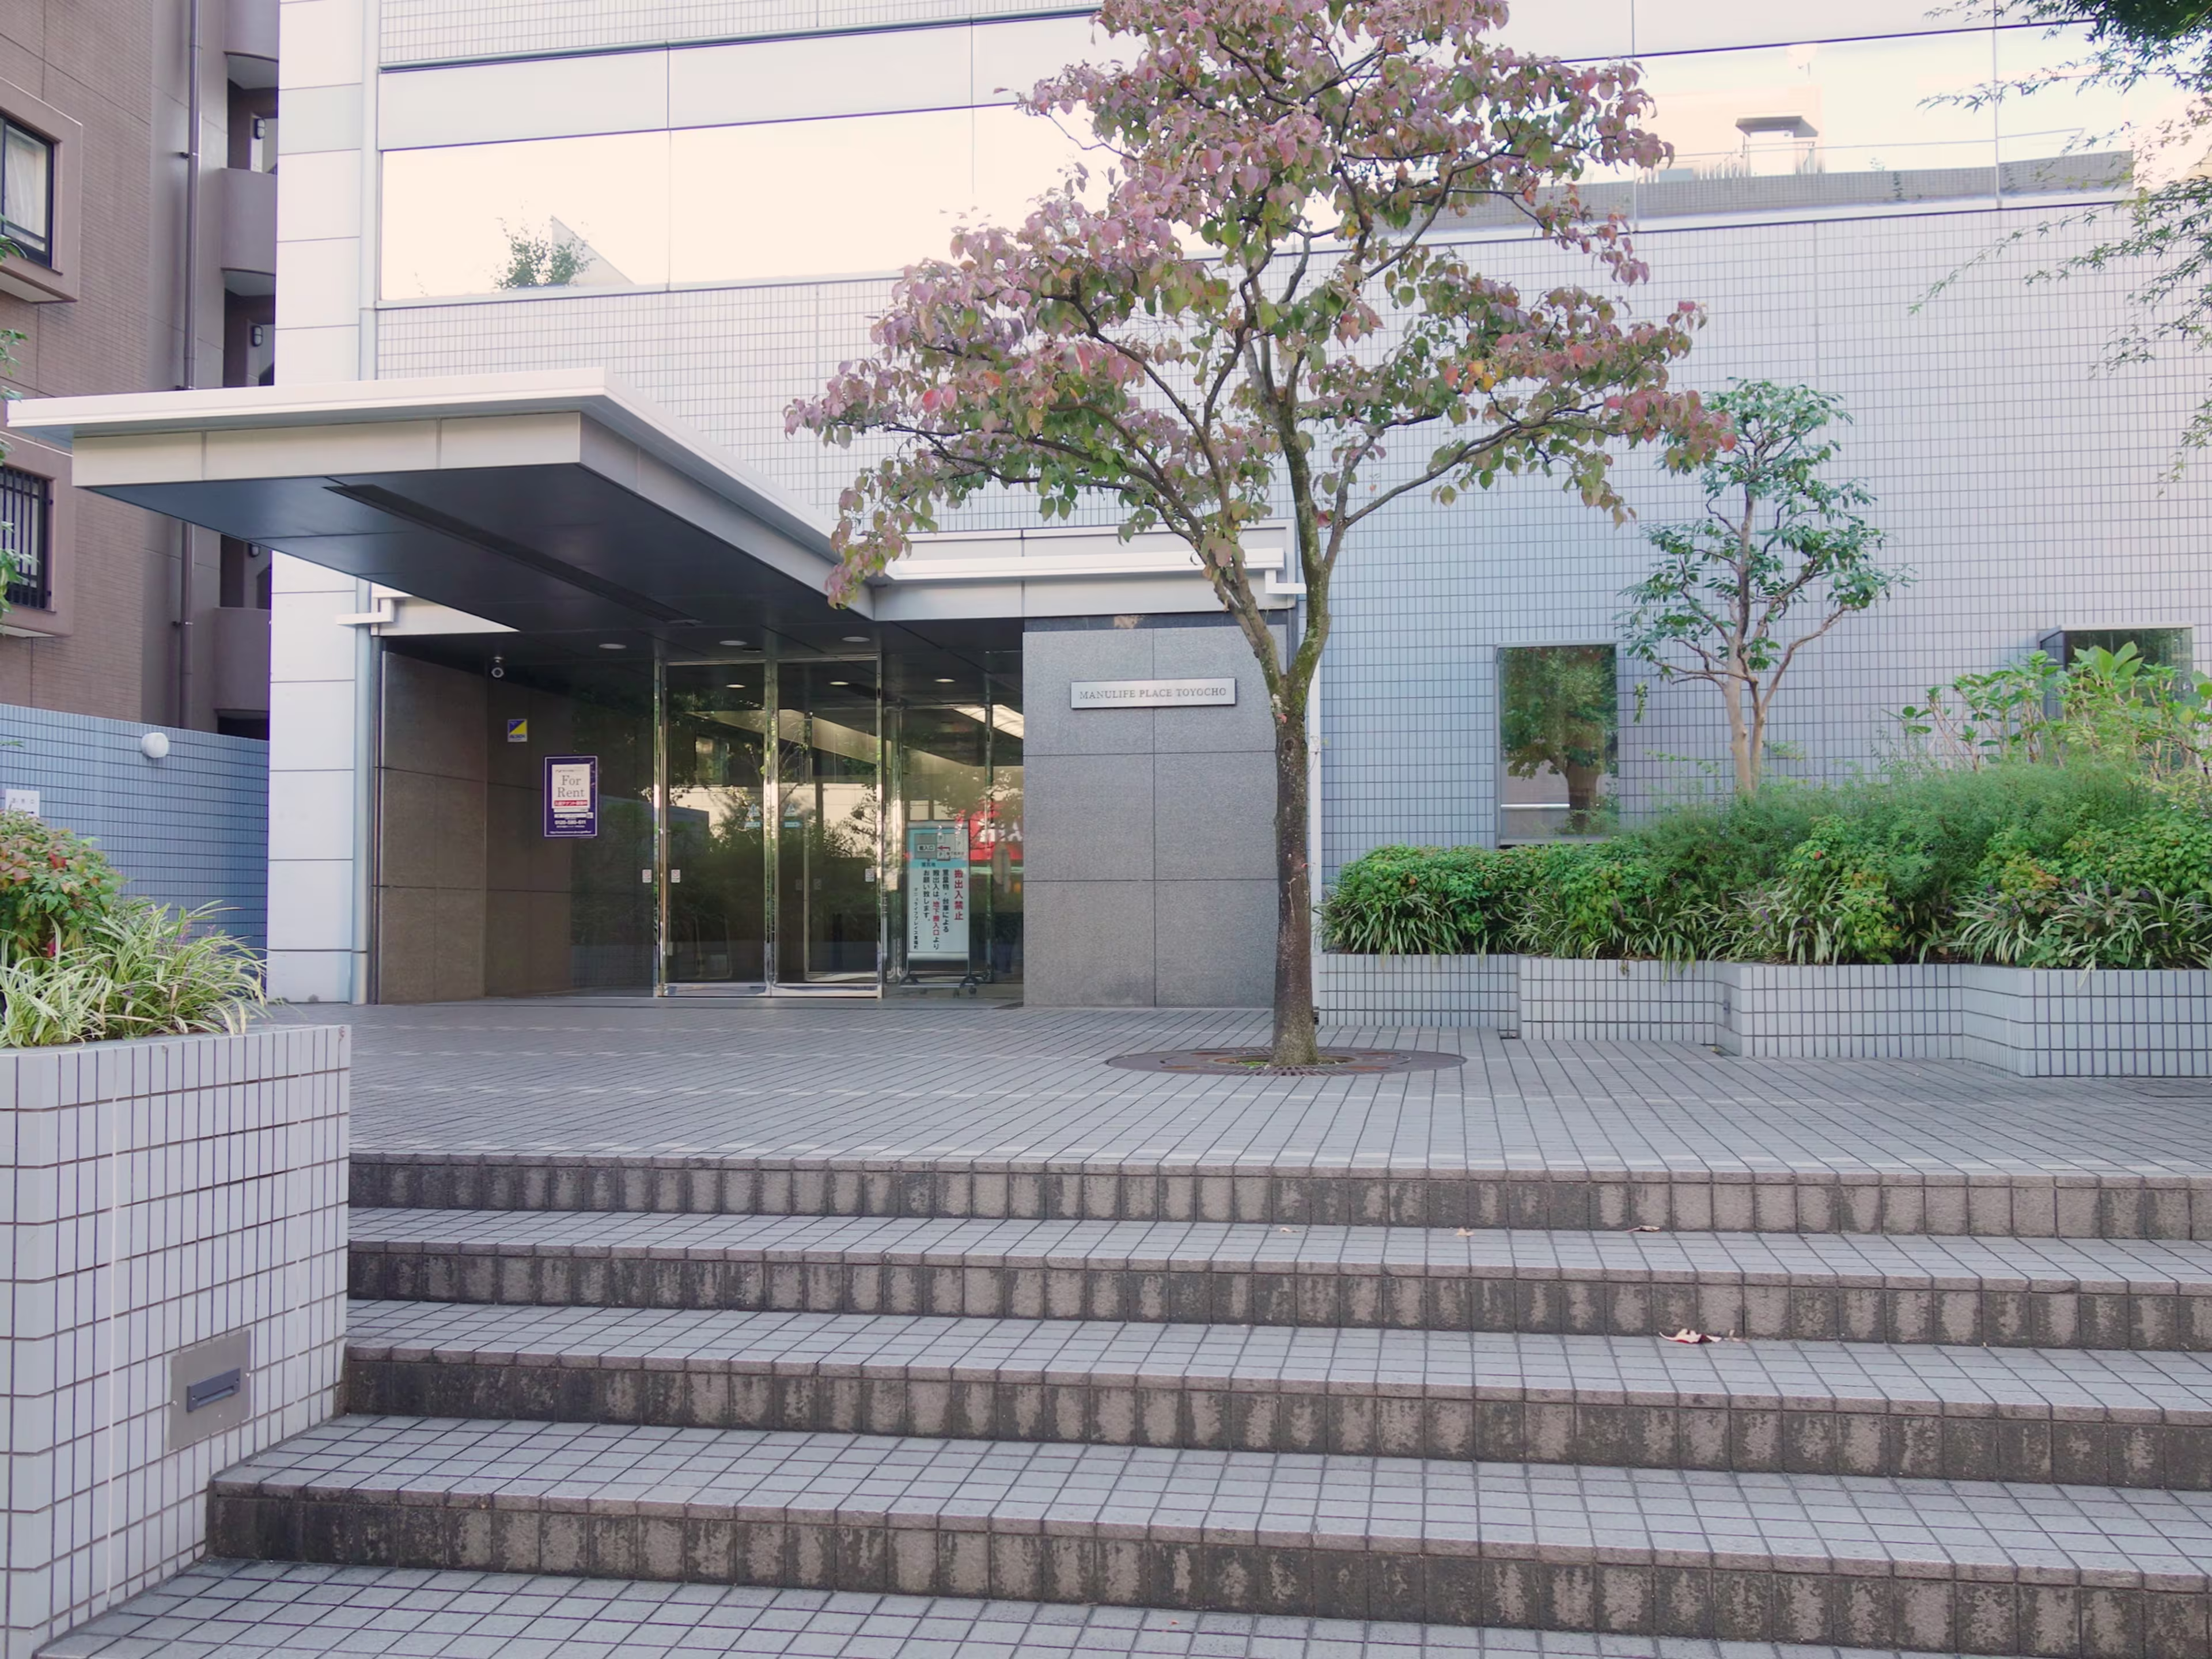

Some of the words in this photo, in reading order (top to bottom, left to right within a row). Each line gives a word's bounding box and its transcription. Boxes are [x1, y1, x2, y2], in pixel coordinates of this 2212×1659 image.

[1080, 690, 1135, 699] MANULIFE
[1139, 688, 1172, 698] PLACE
[1175, 687, 1226, 697] TOYOCHO
[562, 775, 581, 786] For
[557, 787, 585, 798] Rent
[923, 870, 931, 921] お願い致します。
[954, 869, 964, 921] 搬出入禁止
